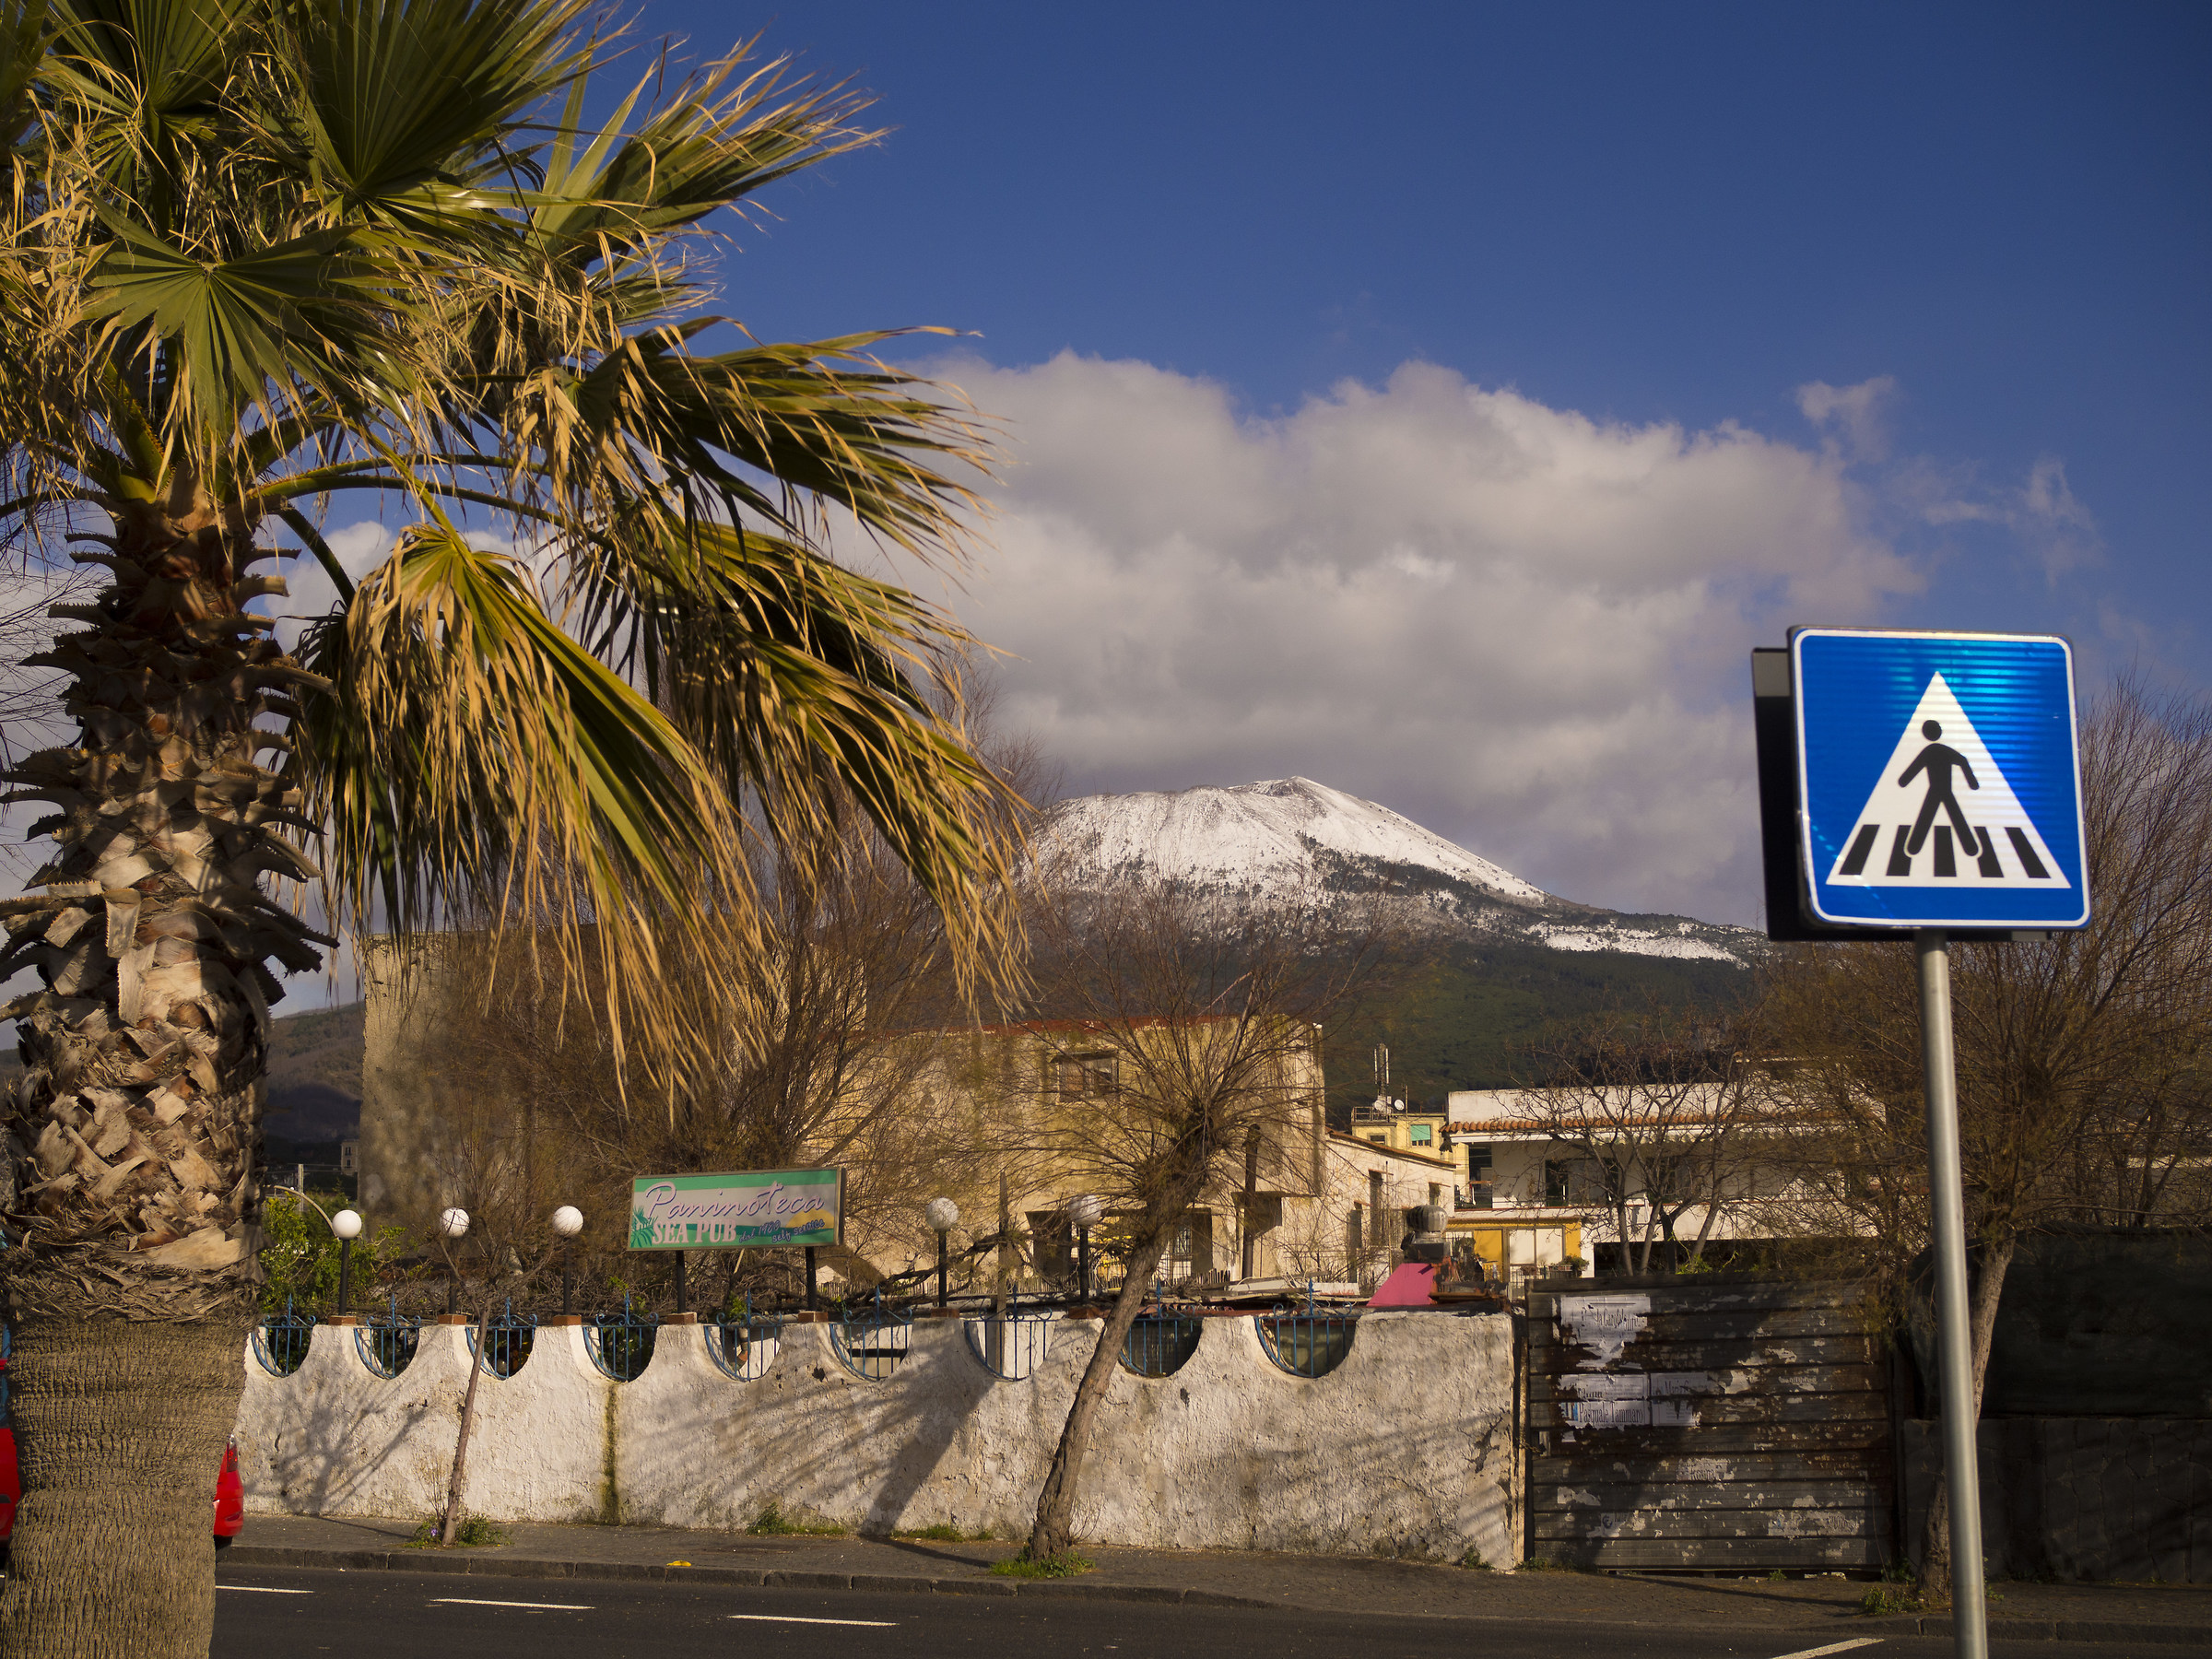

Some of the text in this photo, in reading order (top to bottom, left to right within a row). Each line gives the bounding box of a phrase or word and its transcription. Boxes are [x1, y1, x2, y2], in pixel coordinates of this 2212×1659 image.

[645, 1181, 825, 1219] Paninoteca
[653, 1219, 737, 1244] SEA PUB
[1580, 1402, 1642, 1426] Pasquale Tammaro
